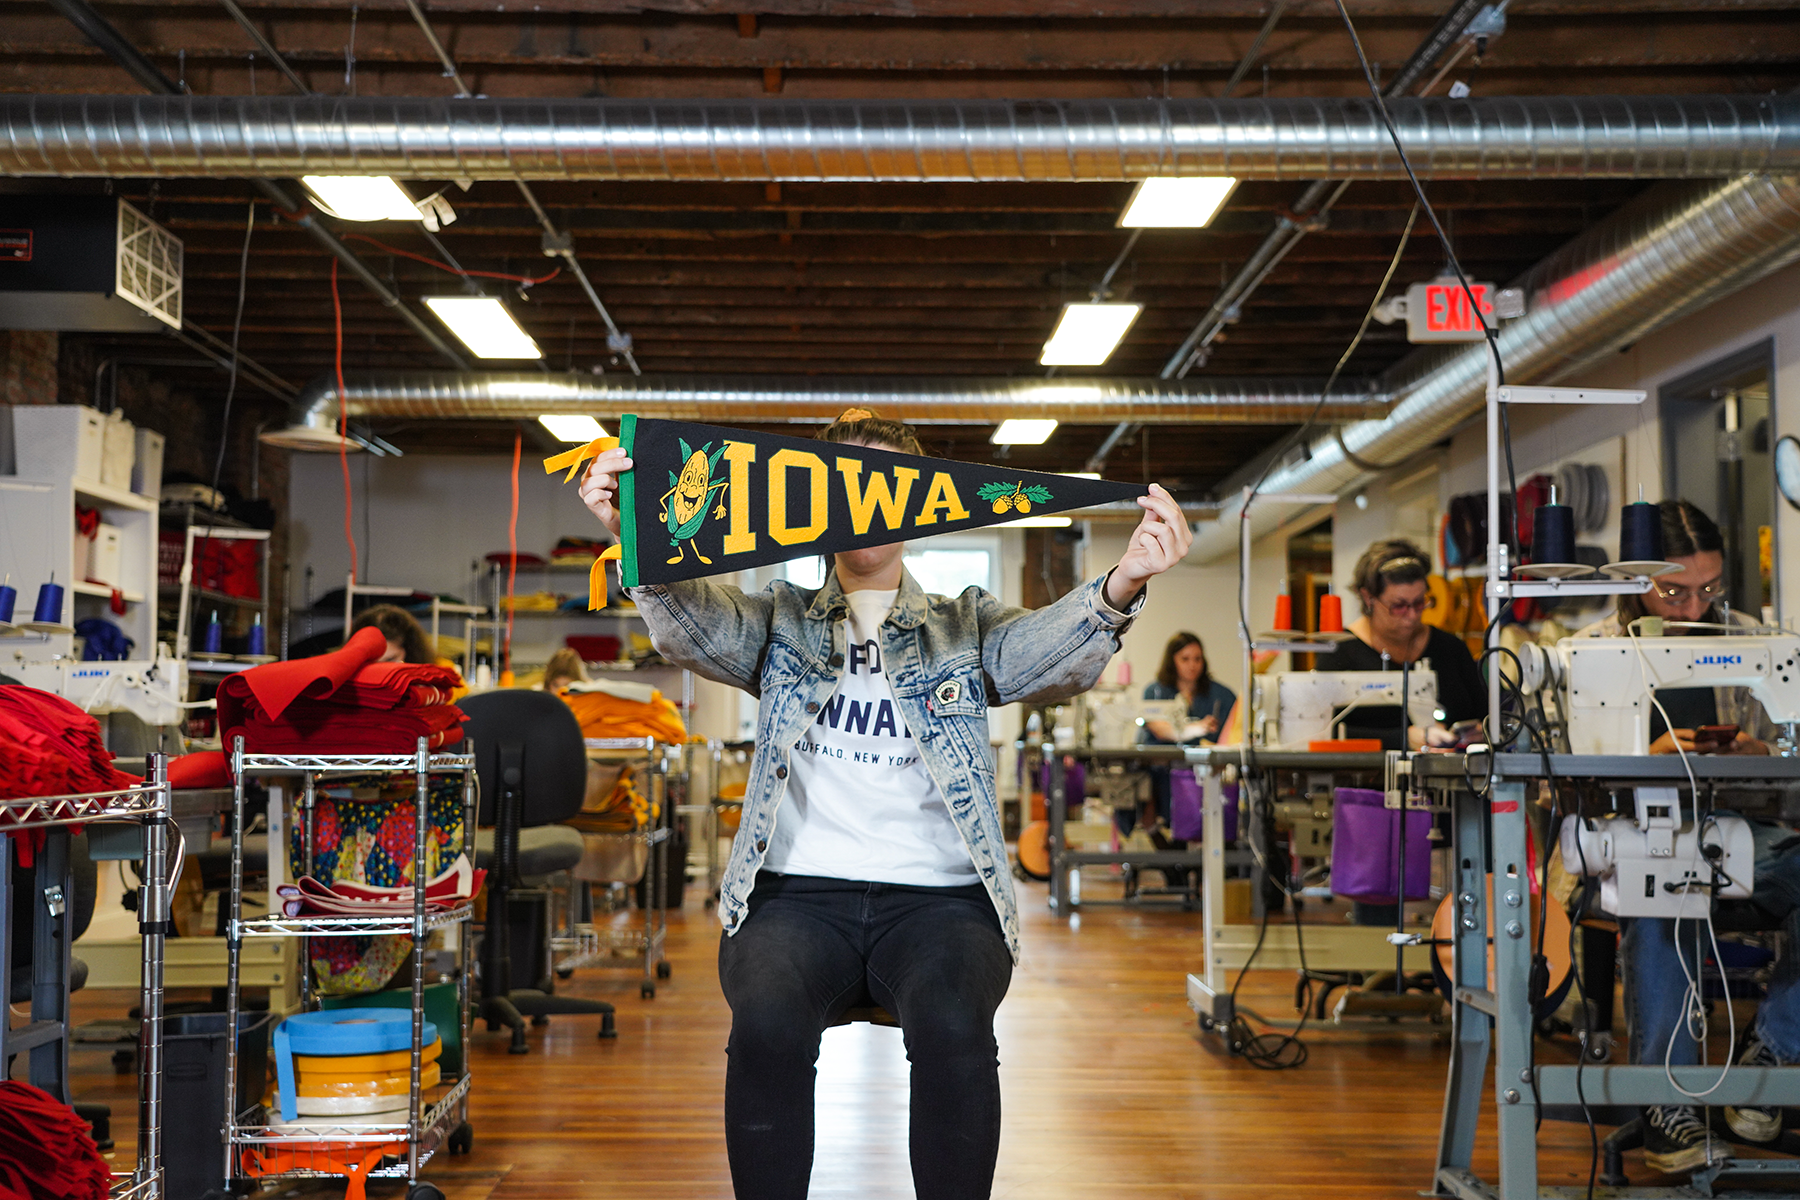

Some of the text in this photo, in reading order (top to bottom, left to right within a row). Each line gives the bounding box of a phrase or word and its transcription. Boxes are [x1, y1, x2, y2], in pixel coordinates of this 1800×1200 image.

[1426, 285, 1487, 332] EXIT
[723, 439, 970, 556] IOWA
[72, 669, 110, 678] JUKI
[850, 638, 889, 681] FO
[1695, 655, 1742, 665] JUKI
[816, 693, 912, 739] NNA
[853, 751, 880, 764] NEW
[888, 755, 919, 766] YORK
